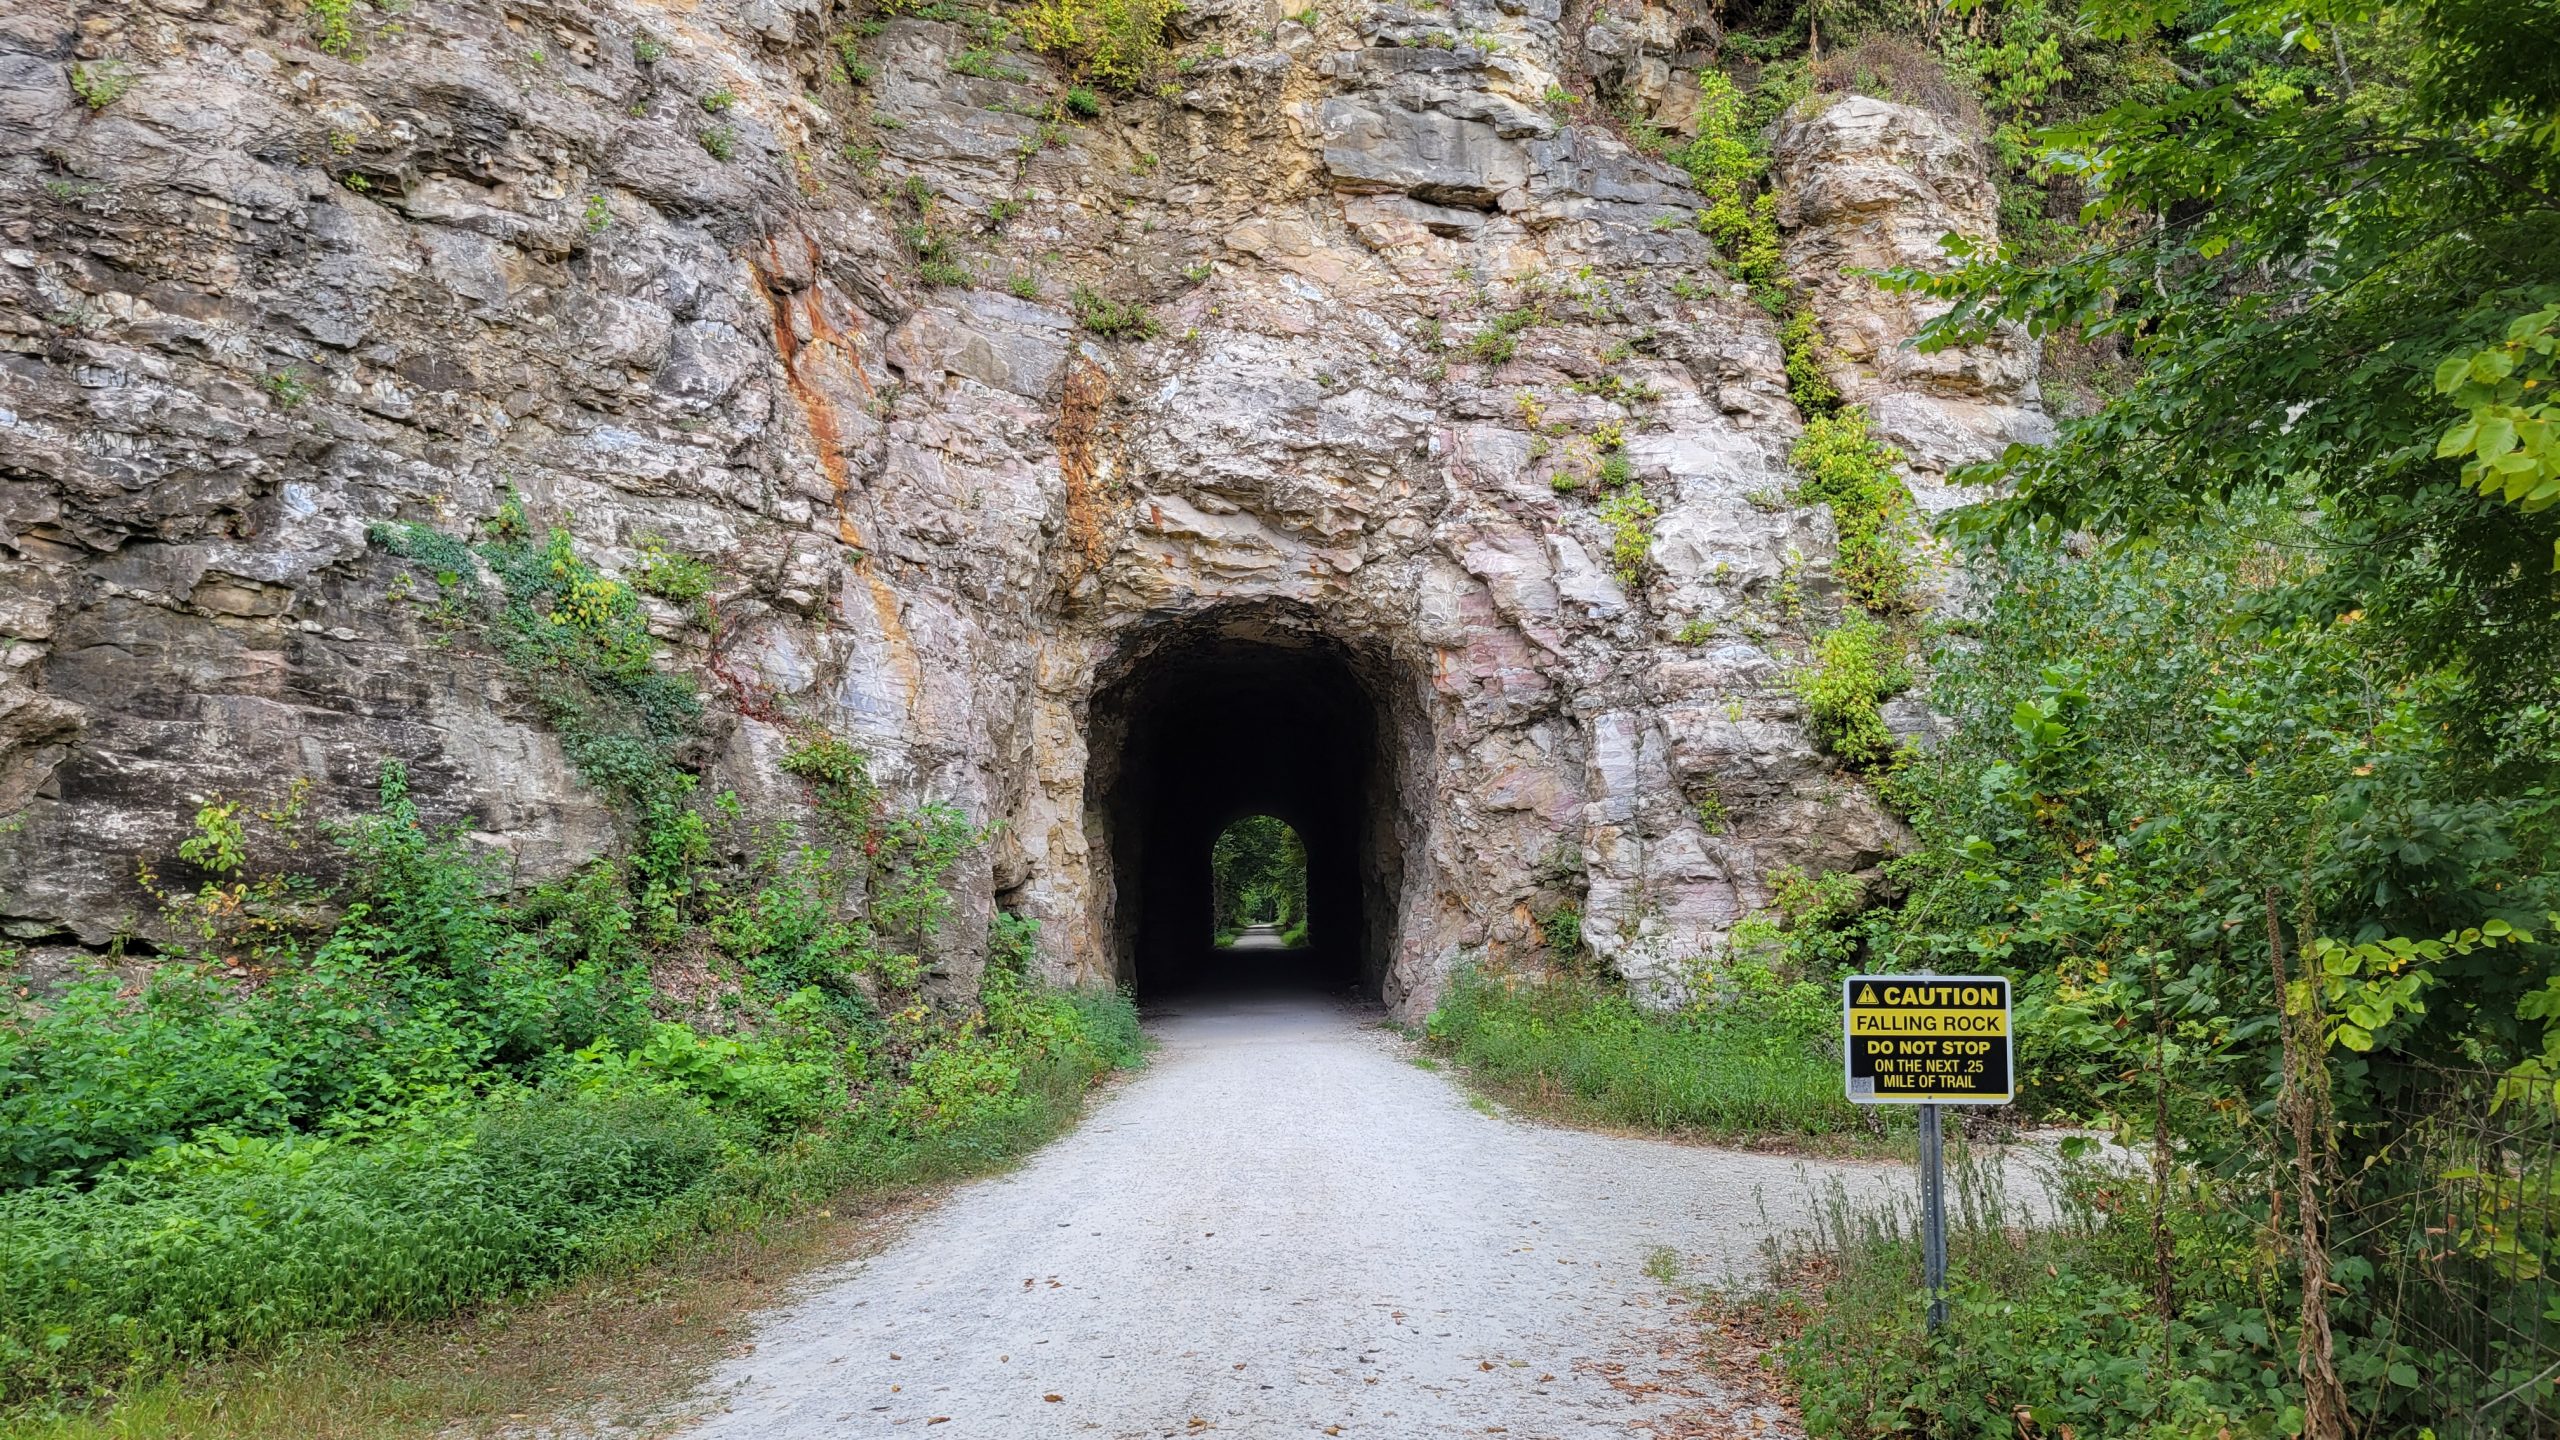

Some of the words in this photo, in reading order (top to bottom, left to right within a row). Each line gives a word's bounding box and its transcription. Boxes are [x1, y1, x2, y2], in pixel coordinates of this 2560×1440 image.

[1884, 987, 1998, 1005] CAUTION
[1857, 1016, 1937, 1031] FALLING
[1944, 1017, 2000, 1031] ROCK
[1868, 1041, 1893, 1054] DO
[1900, 1042, 1937, 1055] NOT
[1942, 1041, 1991, 1055] STOP
[1875, 1060, 1893, 1072] ON
[1898, 1060, 1922, 1072] THE
[1926, 1060, 1960, 1072] NEXT
[1964, 1060, 1983, 1073] .25
[1884, 1075, 1915, 1087] MILE
[1919, 1075, 1935, 1088] OF
[1939, 1075, 1976, 1088] TRAIL
